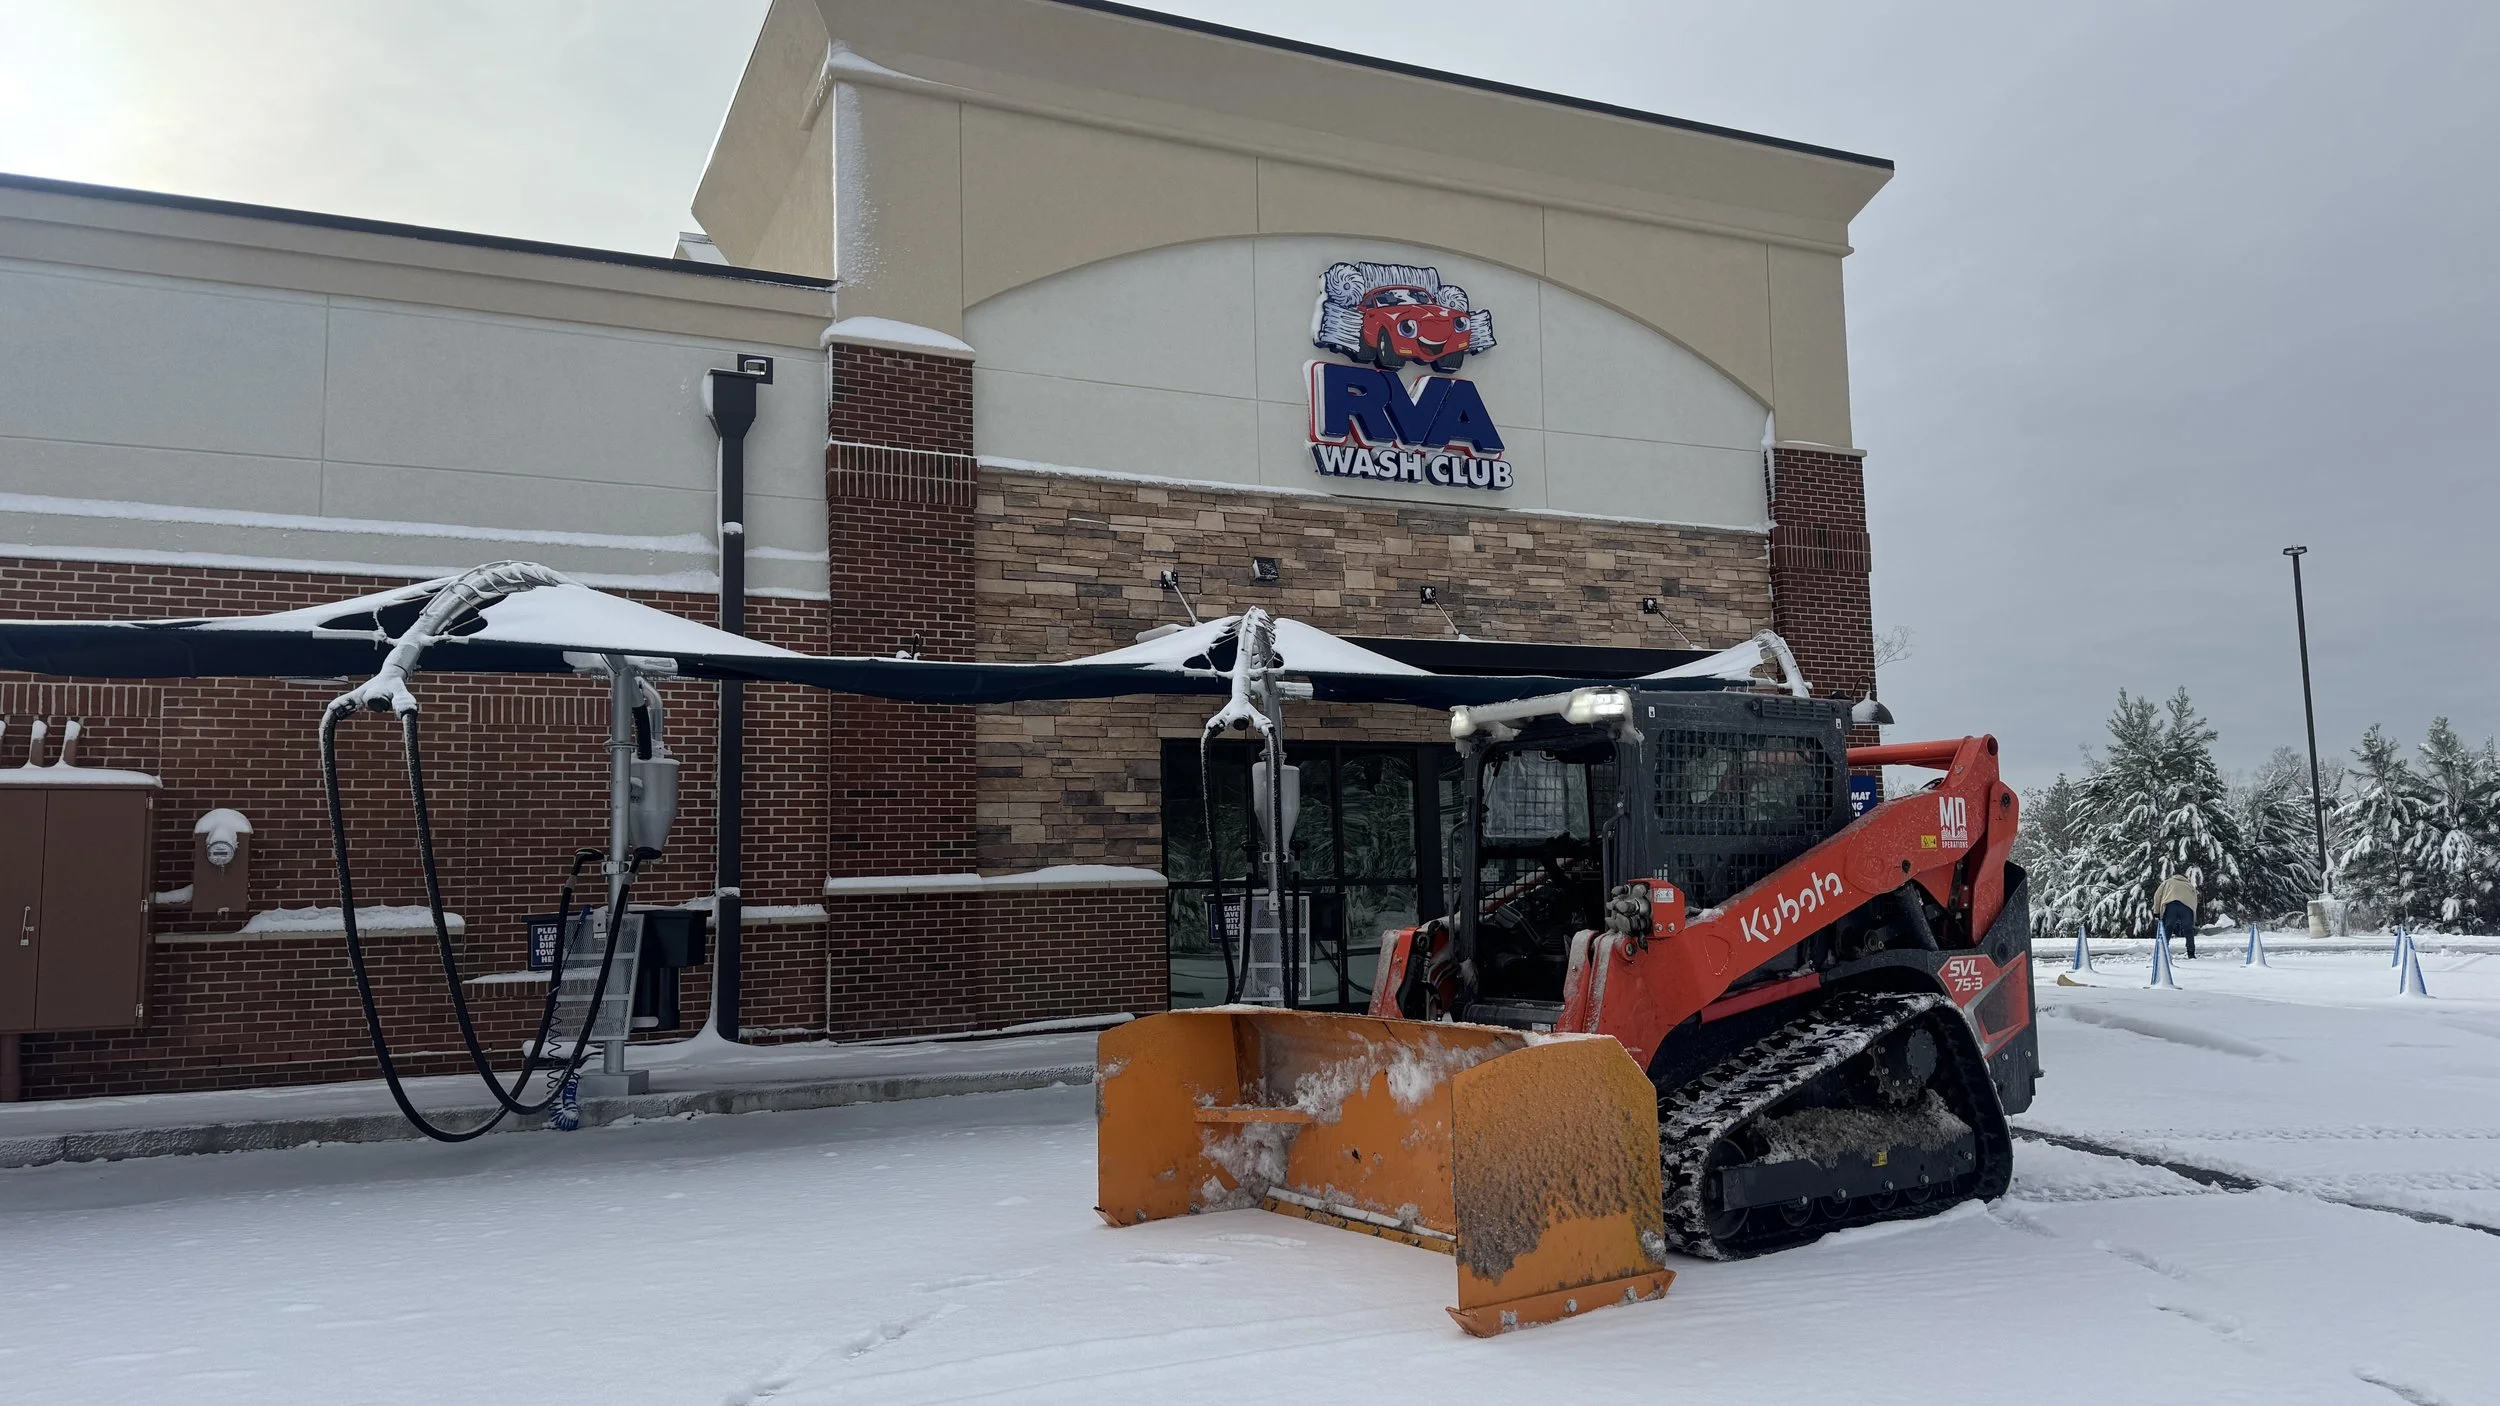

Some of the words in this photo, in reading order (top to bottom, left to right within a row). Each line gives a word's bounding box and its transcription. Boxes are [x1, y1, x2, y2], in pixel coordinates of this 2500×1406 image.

[1311, 361, 1505, 456] RVA
[1314, 445, 1424, 484] WASH
[1428, 452, 1514, 489] CLUB
[1851, 792, 1870, 800] MAT
[1938, 796, 1966, 837] MD
[1739, 871, 1844, 943] Kubota
[1948, 960, 1982, 978] SVL
[1954, 977, 1983, 992] 75-3
